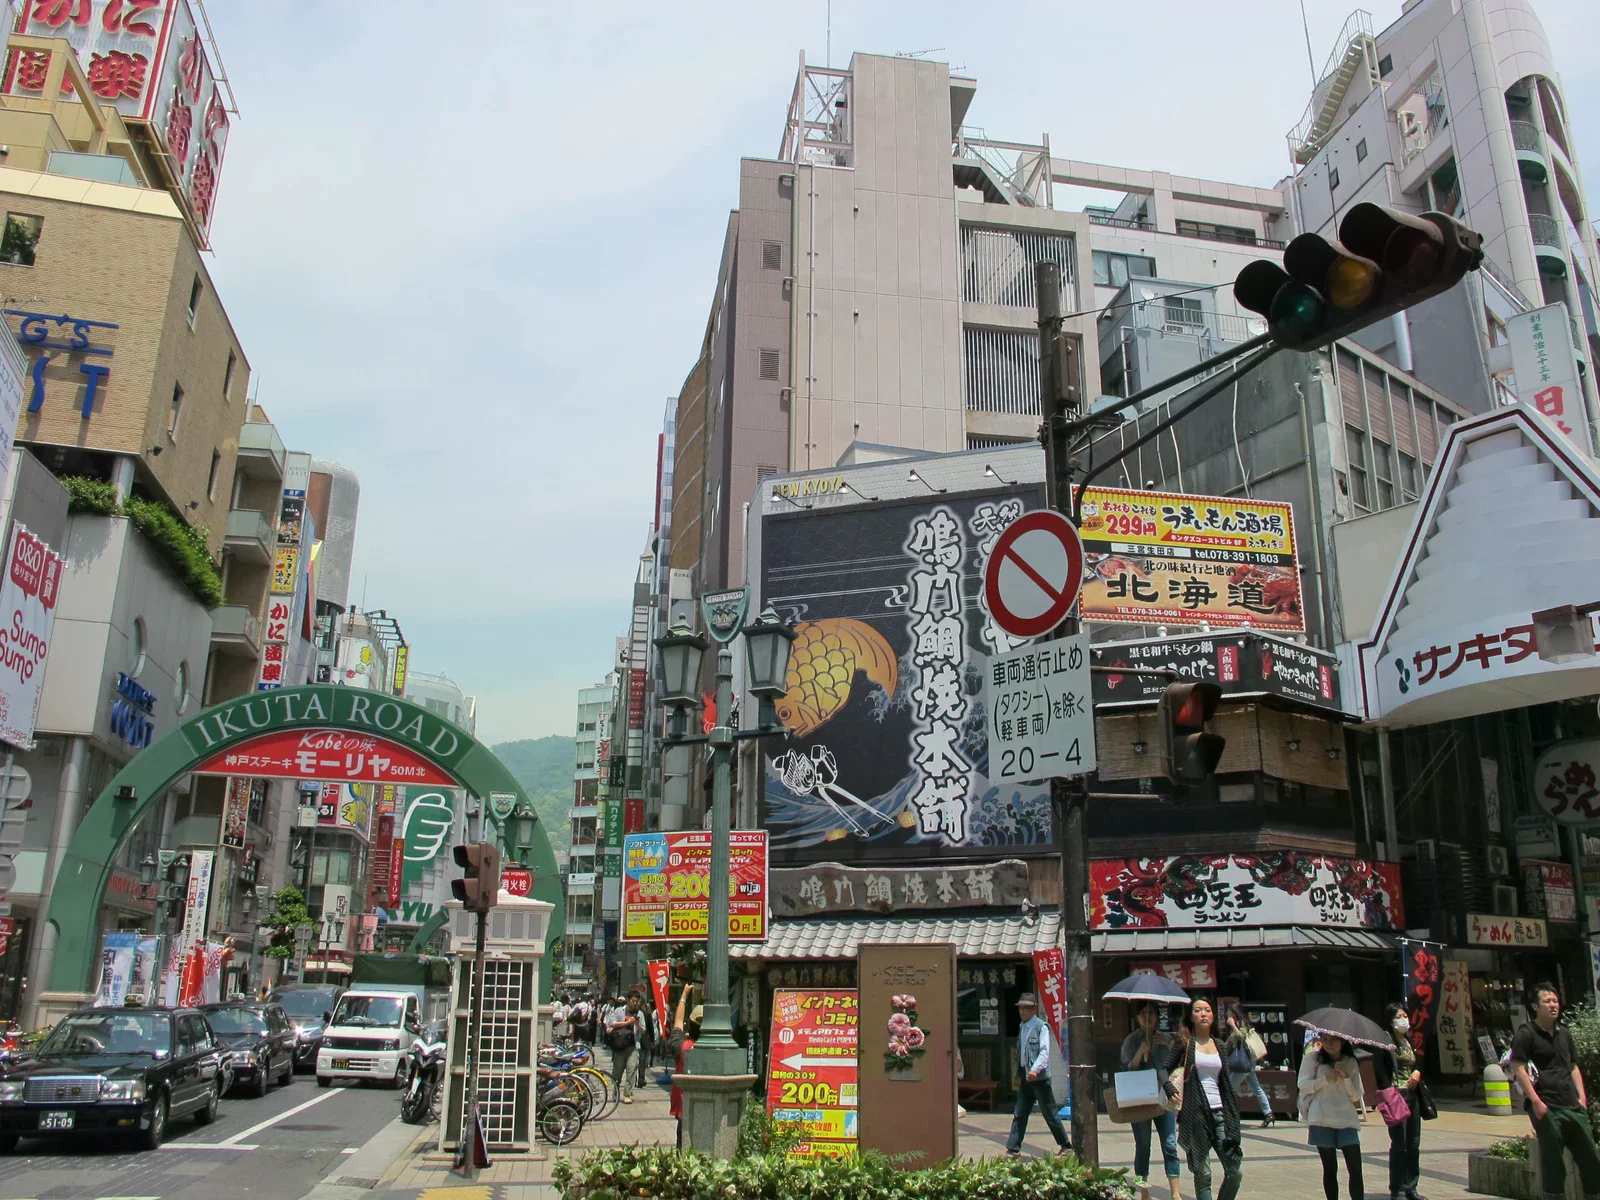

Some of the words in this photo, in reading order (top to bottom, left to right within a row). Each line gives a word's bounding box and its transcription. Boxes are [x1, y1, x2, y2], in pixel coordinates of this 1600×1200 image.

[1105, 513, 1158, 538] 299円
[1161, 504, 1284, 537] うまいもん酒場
[1127, 544, 1175, 556] 三宮生田店
[1194, 548, 1280, 564] tel.078-391-1803
[1144, 559, 1237, 576] 北の味紀行と地酒
[1106, 572, 1276, 615] 北海道
[268, 602, 289, 640] かに
[1116, 606, 1182, 617] TEL.078-334-0061
[10, 609, 48, 665] Sumo
[908, 509, 972, 846] 鳴門鯛焼本舗
[992, 643, 1083, 688] 車両通行止め
[1222, 647, 1234, 681] 大阪名物
[195, 693, 328, 748] IKUTA
[349, 694, 459, 757] ROAD
[225, 753, 292, 769] 神戸ステーキ
[294, 750, 391, 777] モーリヤ
[628, 840, 667, 848] ソフトクリーム
[501, 879, 527, 891] 消火栓
[799, 869, 995, 908] 鳴門鯛焼本舗
[1174, 882, 1264, 911] 四天王
[1309, 883, 1355, 911] 四天王
[1194, 909, 1248, 924] ラーメン
[1319, 909, 1348, 924] ラーメン
[1038, 956, 1060, 973] 餃子
[46, 1118, 73, 1128] 51-09
